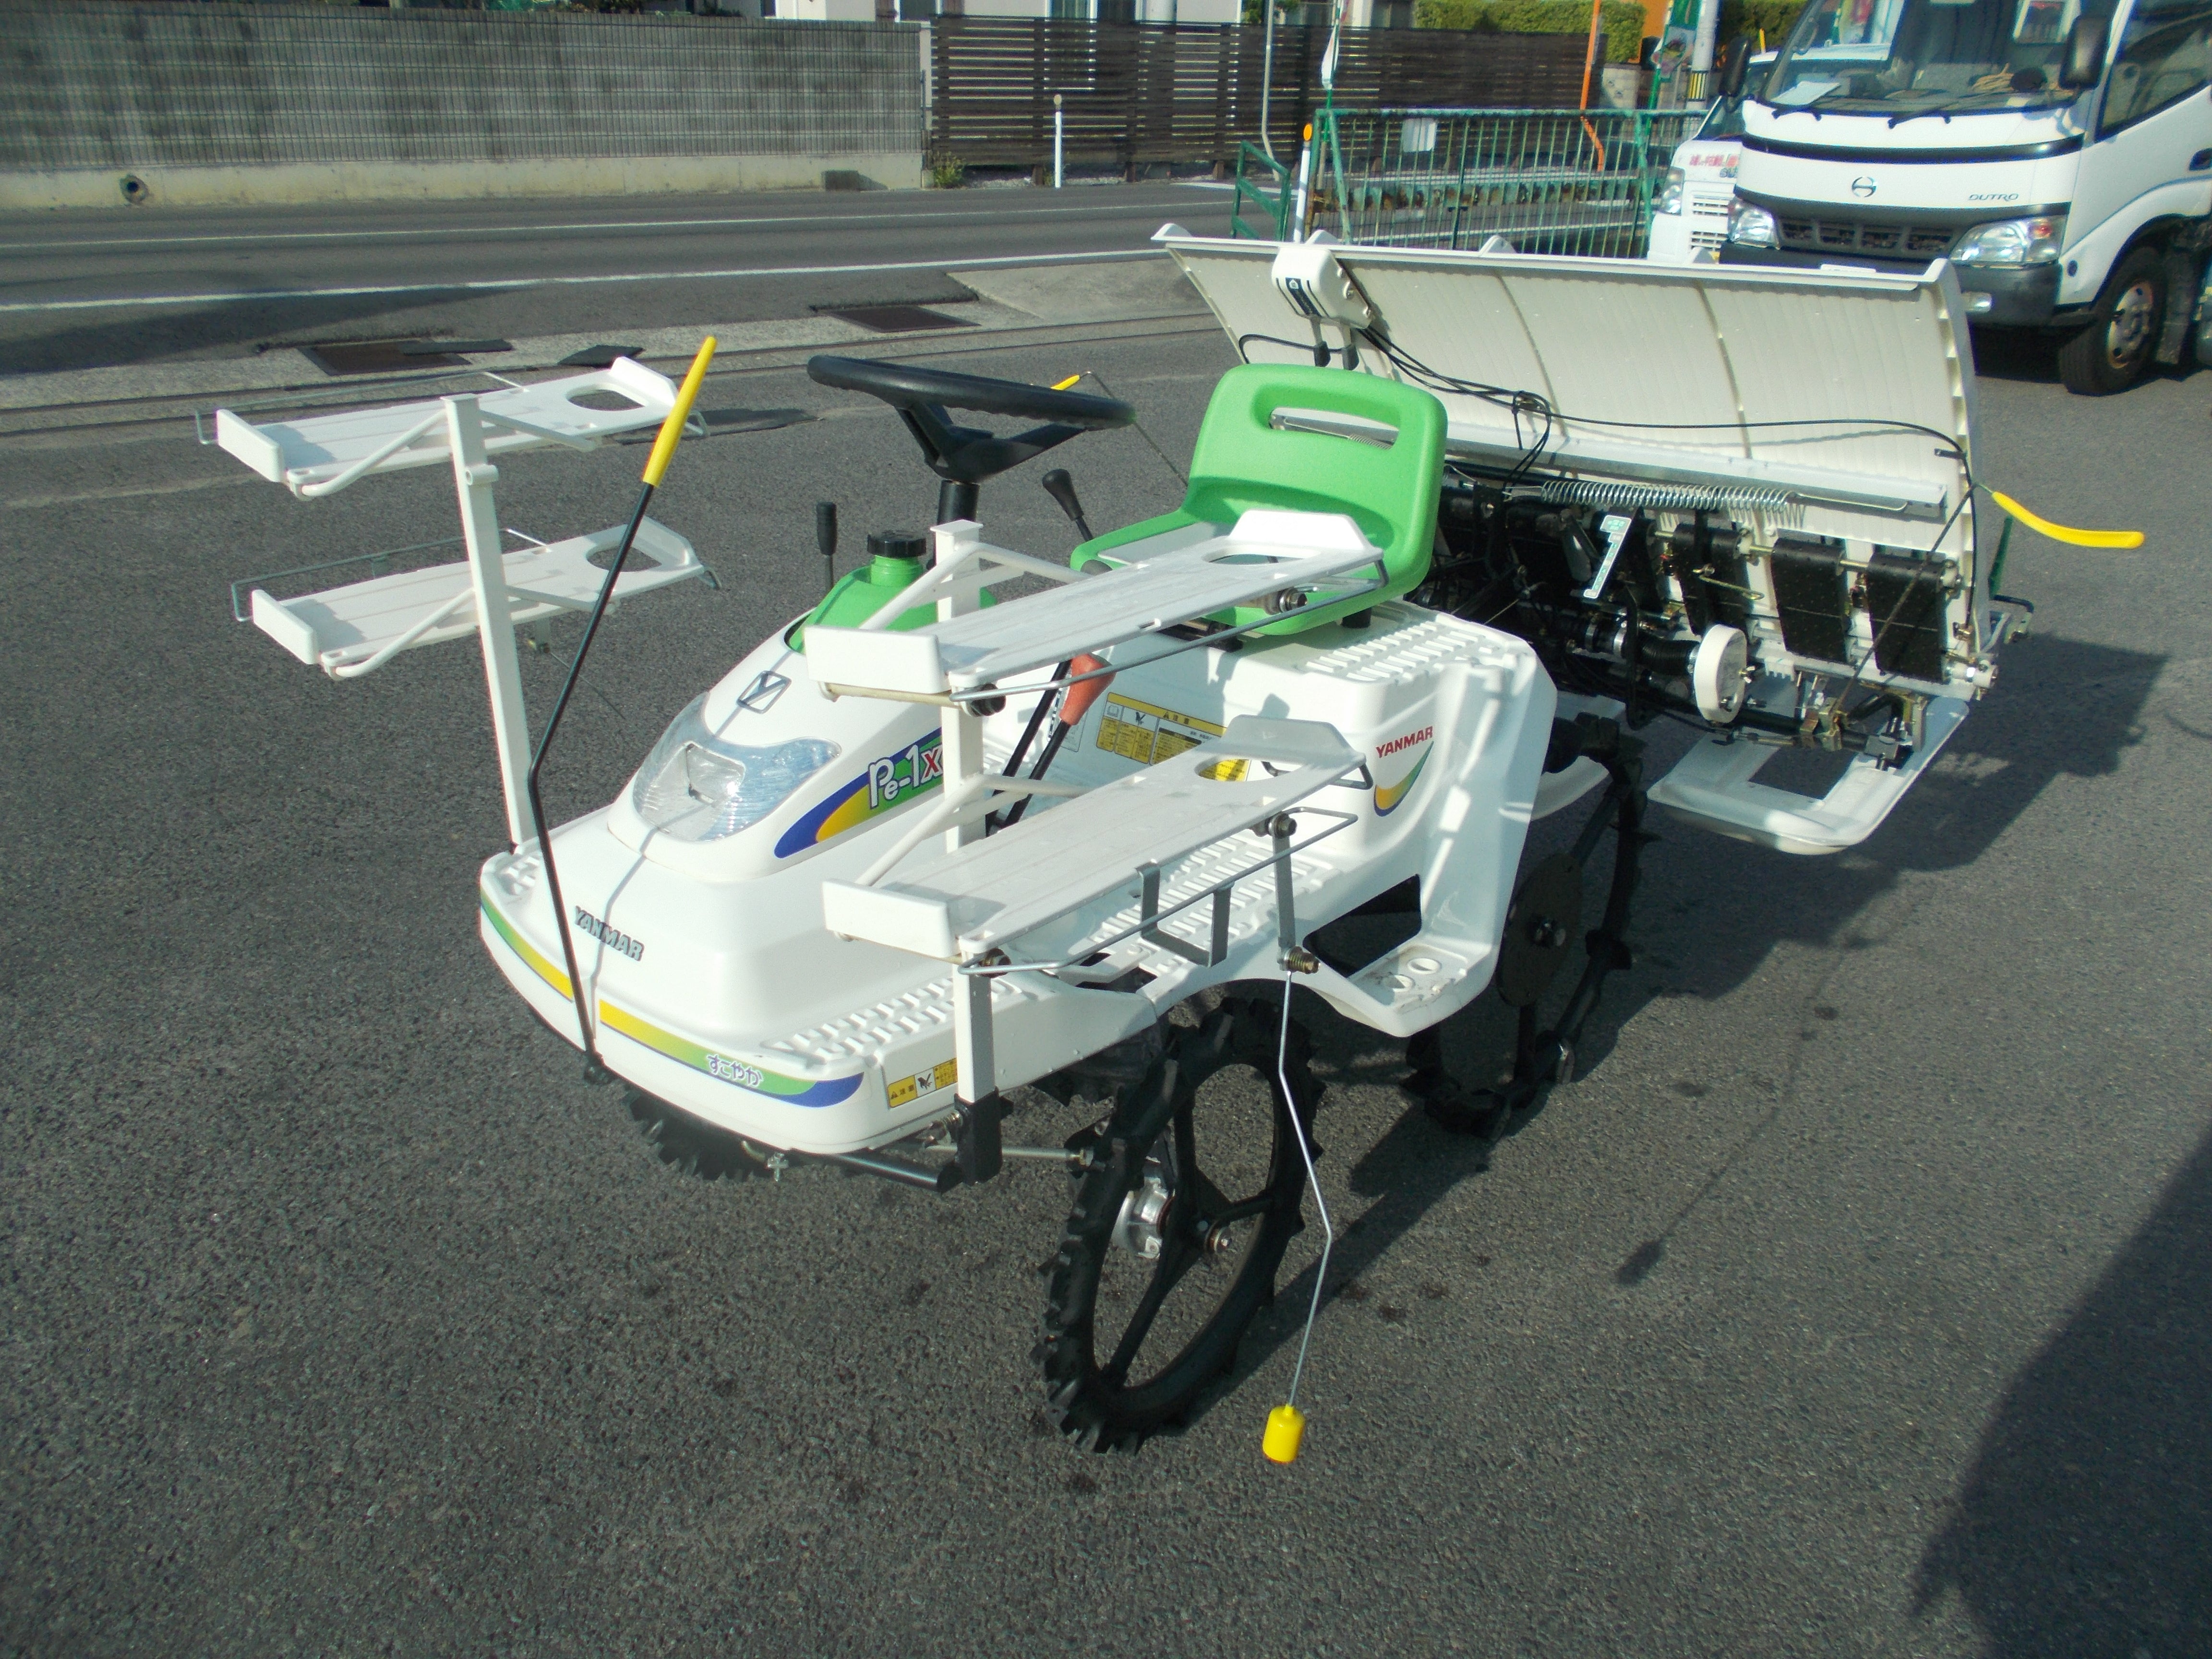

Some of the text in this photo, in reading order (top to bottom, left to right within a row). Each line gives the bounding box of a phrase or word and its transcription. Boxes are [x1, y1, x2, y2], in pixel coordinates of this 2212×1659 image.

[1968, 193, 2019, 202] DUTRO
[1376, 726, 1433, 758] YANMAR
[575, 905, 645, 961] YANMAR
[707, 1054, 763, 1086] すこやか
